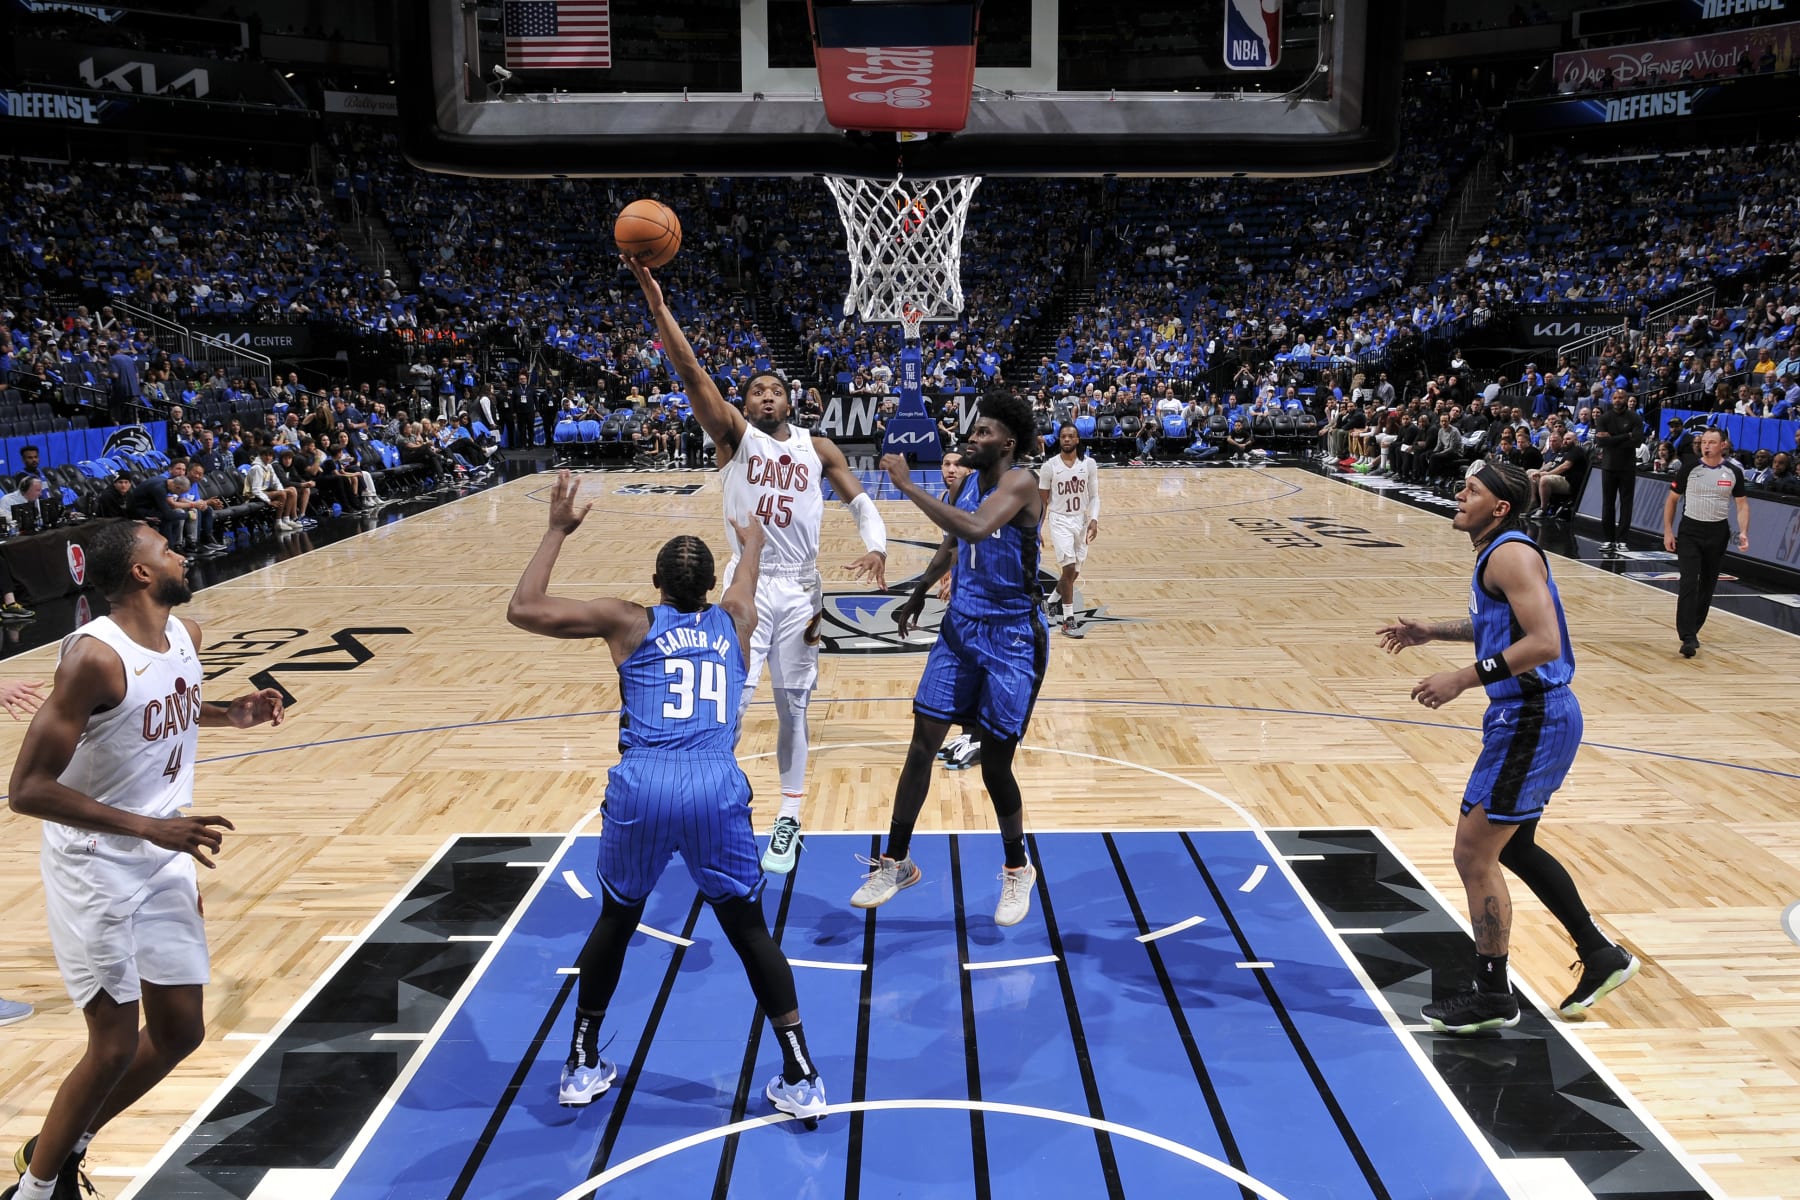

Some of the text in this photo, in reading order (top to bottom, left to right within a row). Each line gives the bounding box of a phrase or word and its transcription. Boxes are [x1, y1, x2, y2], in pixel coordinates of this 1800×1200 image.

[844, 47, 933, 85] Stat
[1233, 40, 1259, 60] NBA
[79, 57, 209, 98] KIA
[8, 91, 99, 124] DEFENSE
[1605, 90, 1692, 123] DEFENSE
[254, 336, 293, 346] CENTER
[1534, 322, 1580, 336] KIA
[888, 432, 935, 444] KIA
[747, 455, 809, 492] CAVS
[1057, 479, 1086, 496] CAVS
[756, 494, 794, 528] 45
[1066, 496, 1080, 512] 10
[1228, 517, 1324, 549] CENTER
[199, 628, 309, 684] CENT
[655, 627, 708, 656] CARTER
[1482, 658, 1497, 672] 5
[662, 658, 728, 724] 34
[142, 683, 200, 741] CAVS
[162, 741, 184, 784] 4
